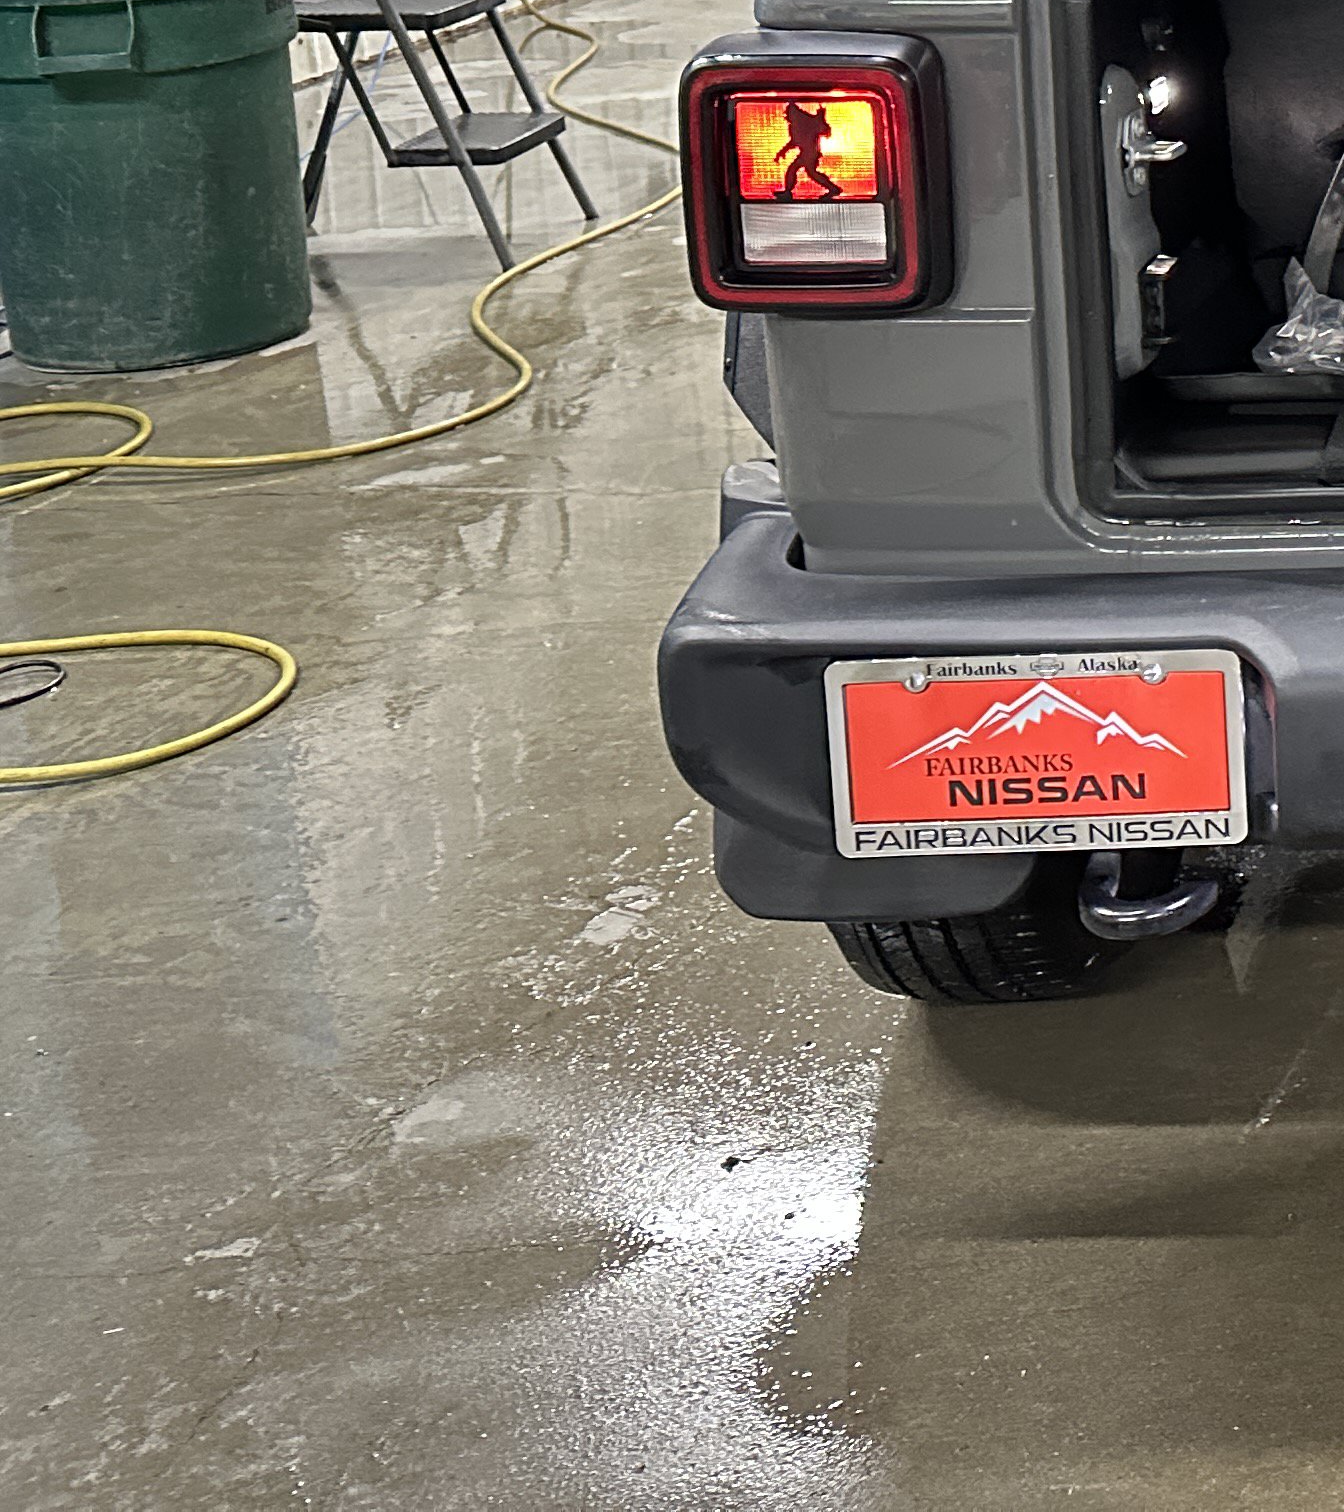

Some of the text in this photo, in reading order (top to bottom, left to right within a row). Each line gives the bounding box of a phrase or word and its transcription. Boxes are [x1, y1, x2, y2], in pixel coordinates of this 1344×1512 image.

[925, 661, 1018, 678] Fairbanks
[1076, 656, 1139, 674] Alaska
[923, 753, 1074, 777] FAIRBANKS
[948, 773, 1146, 807] NISSAN
[854, 817, 1230, 852] FAIRBANKS NISSAN
